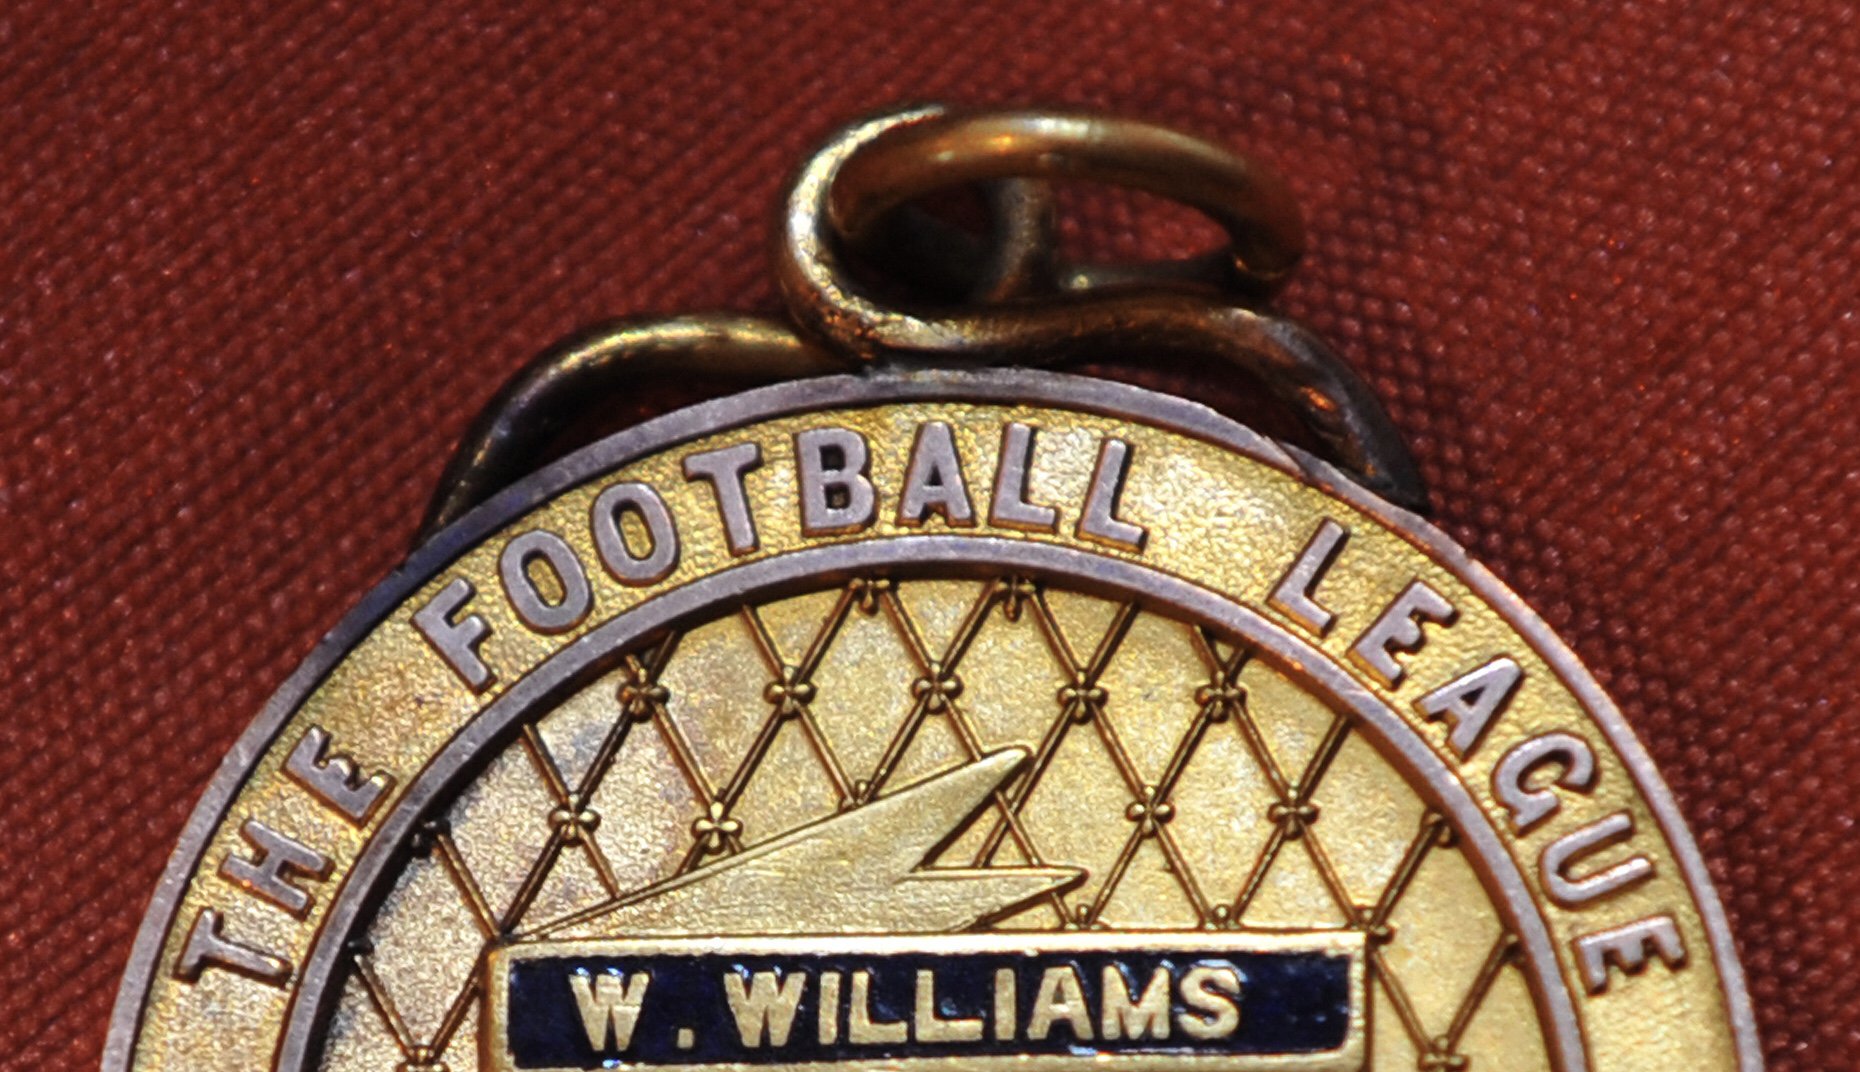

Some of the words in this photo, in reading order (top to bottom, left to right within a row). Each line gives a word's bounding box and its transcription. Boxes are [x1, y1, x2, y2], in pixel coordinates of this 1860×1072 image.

[174, 723, 396, 988] THE
[411, 420, 1148, 696] FOOTBALL
[1266, 516, 1690, 996] LEAGUE
[722, 960, 1244, 1048] WILLIAMS
